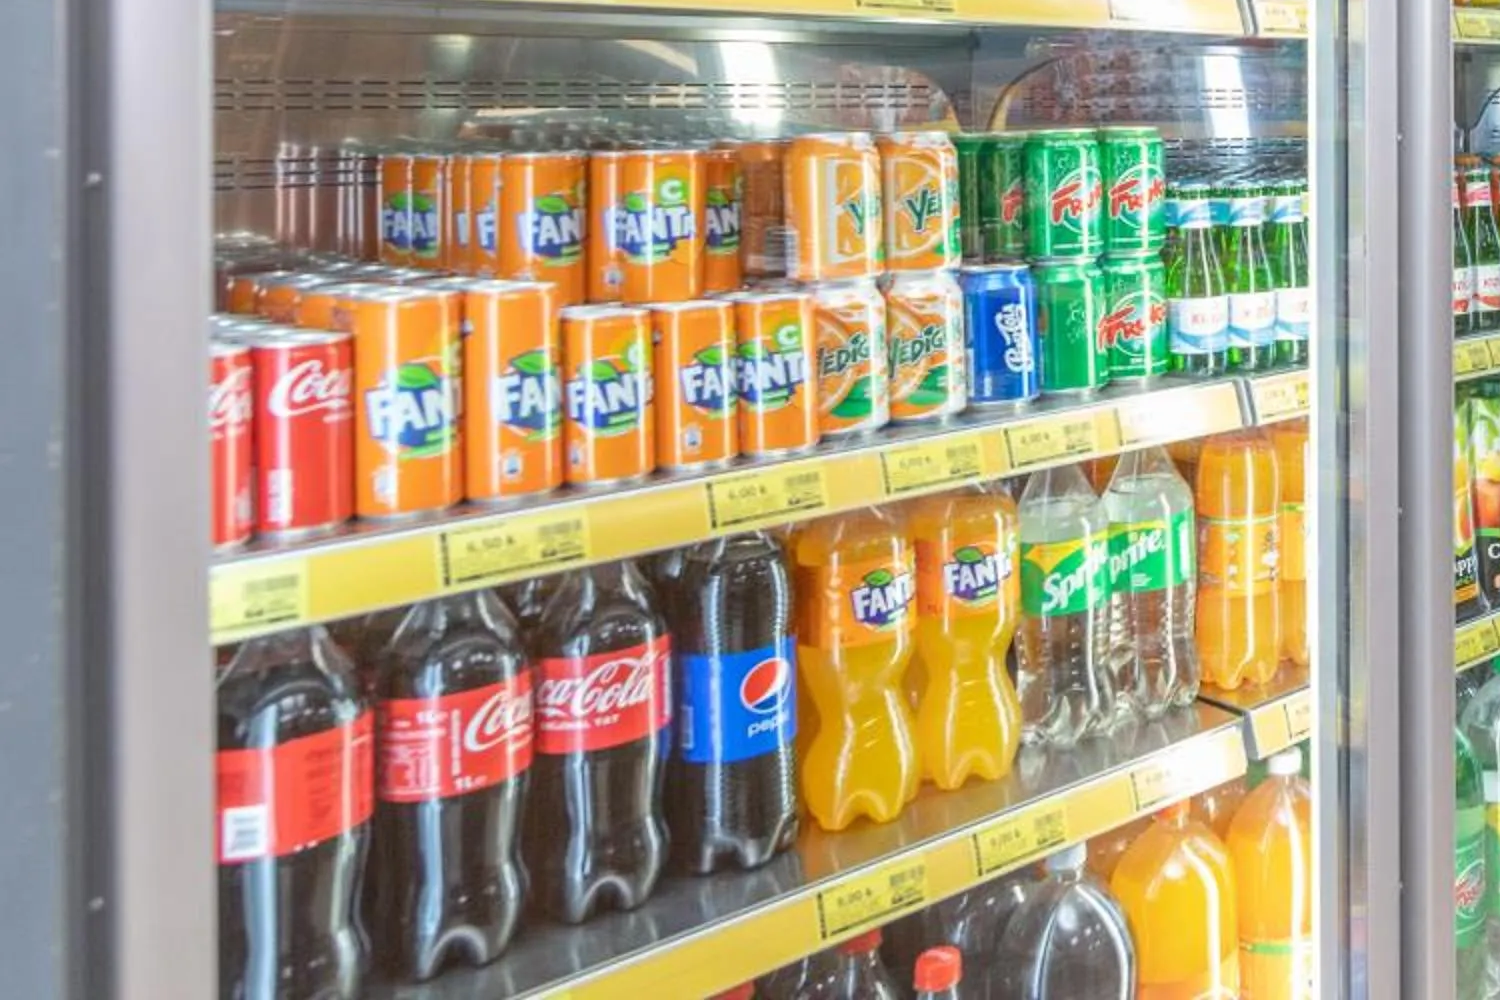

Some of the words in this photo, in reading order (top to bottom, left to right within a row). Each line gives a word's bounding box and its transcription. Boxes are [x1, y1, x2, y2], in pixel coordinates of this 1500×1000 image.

[660, 179, 683, 202] C
[516, 208, 587, 248] FAN
[566, 370, 653, 419] FANT
[681, 360, 738, 404] FAN
[943, 551, 1012, 594] FANT
[1109, 530, 1160, 585] prite
[748, 712, 789, 737] pep
